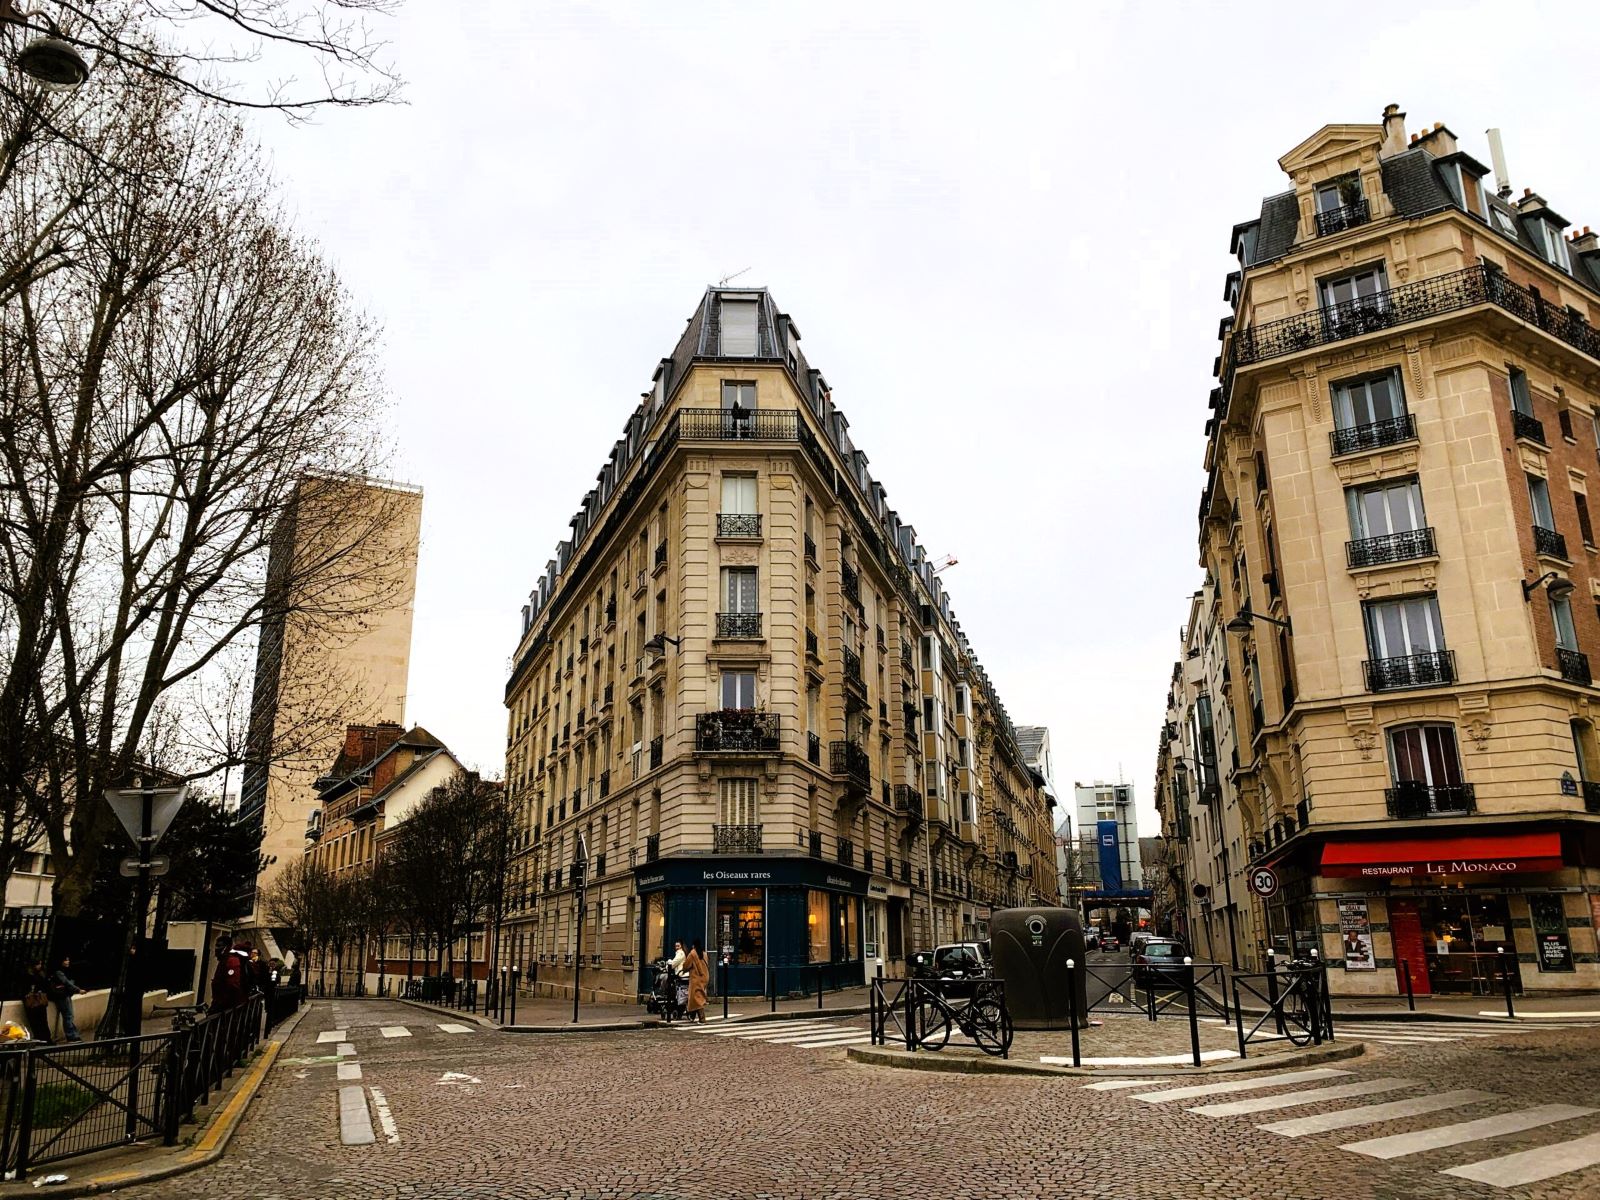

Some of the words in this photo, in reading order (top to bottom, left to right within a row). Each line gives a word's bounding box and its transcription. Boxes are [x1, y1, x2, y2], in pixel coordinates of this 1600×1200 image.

[703, 871, 714, 880] les
[716, 870, 749, 880] Oiseaux
[751, 871, 771, 880] rares
[1362, 866, 1414, 875] RESTAURANT
[1256, 875, 1273, 889] 30
